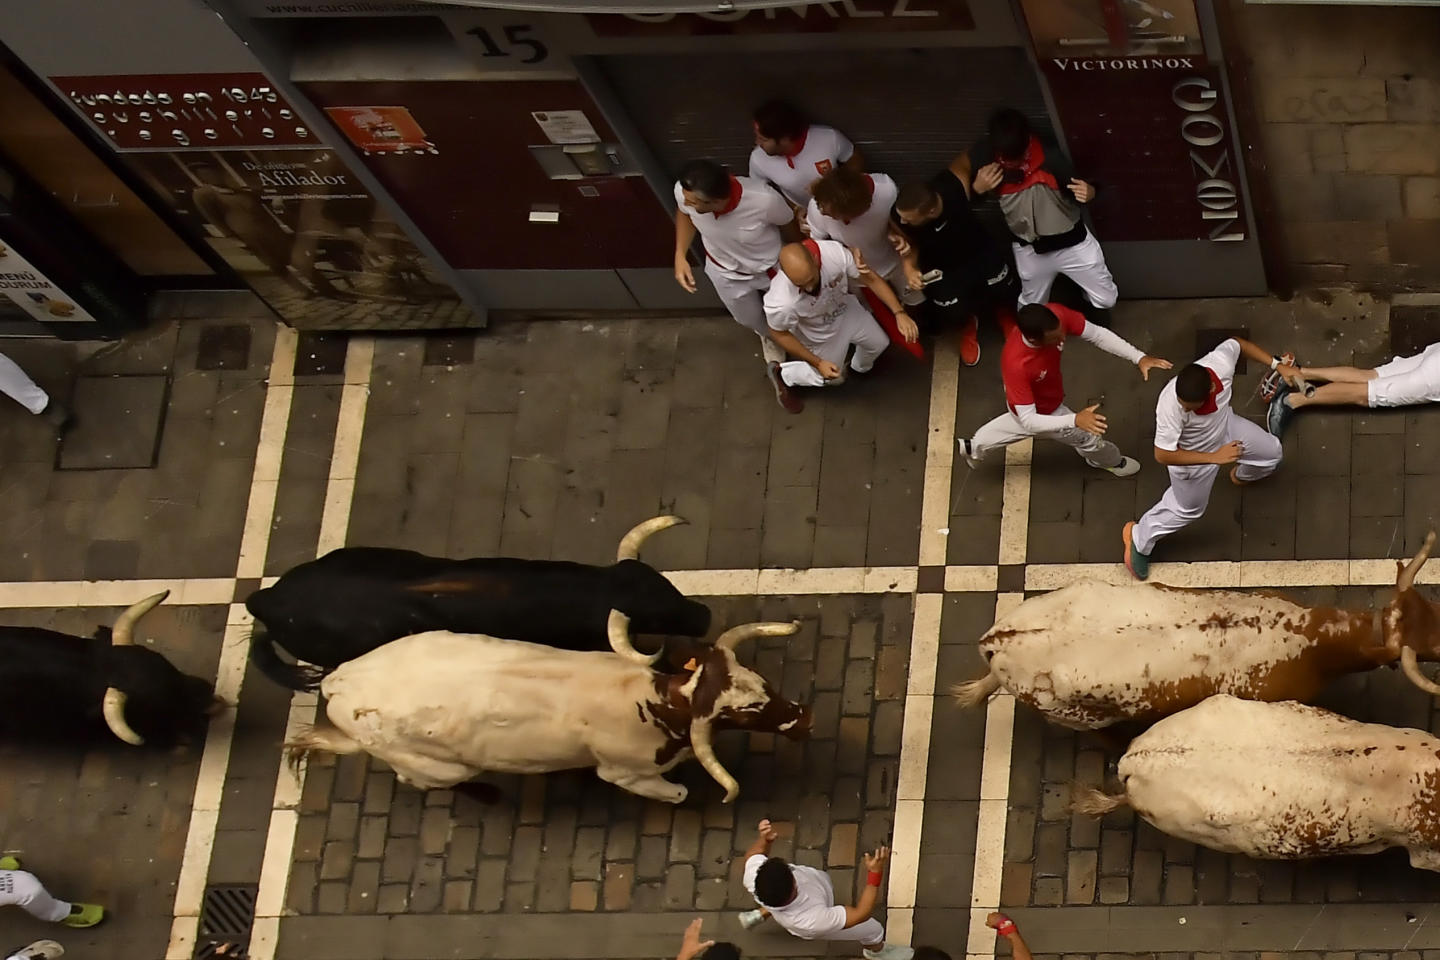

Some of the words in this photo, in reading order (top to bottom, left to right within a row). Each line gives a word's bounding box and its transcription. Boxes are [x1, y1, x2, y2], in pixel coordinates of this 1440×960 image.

[465, 25, 549, 64] 15
[1053, 57, 1194, 72] VICTORINOX
[182, 92, 214, 105] en
[258, 169, 348, 187] Afilador
